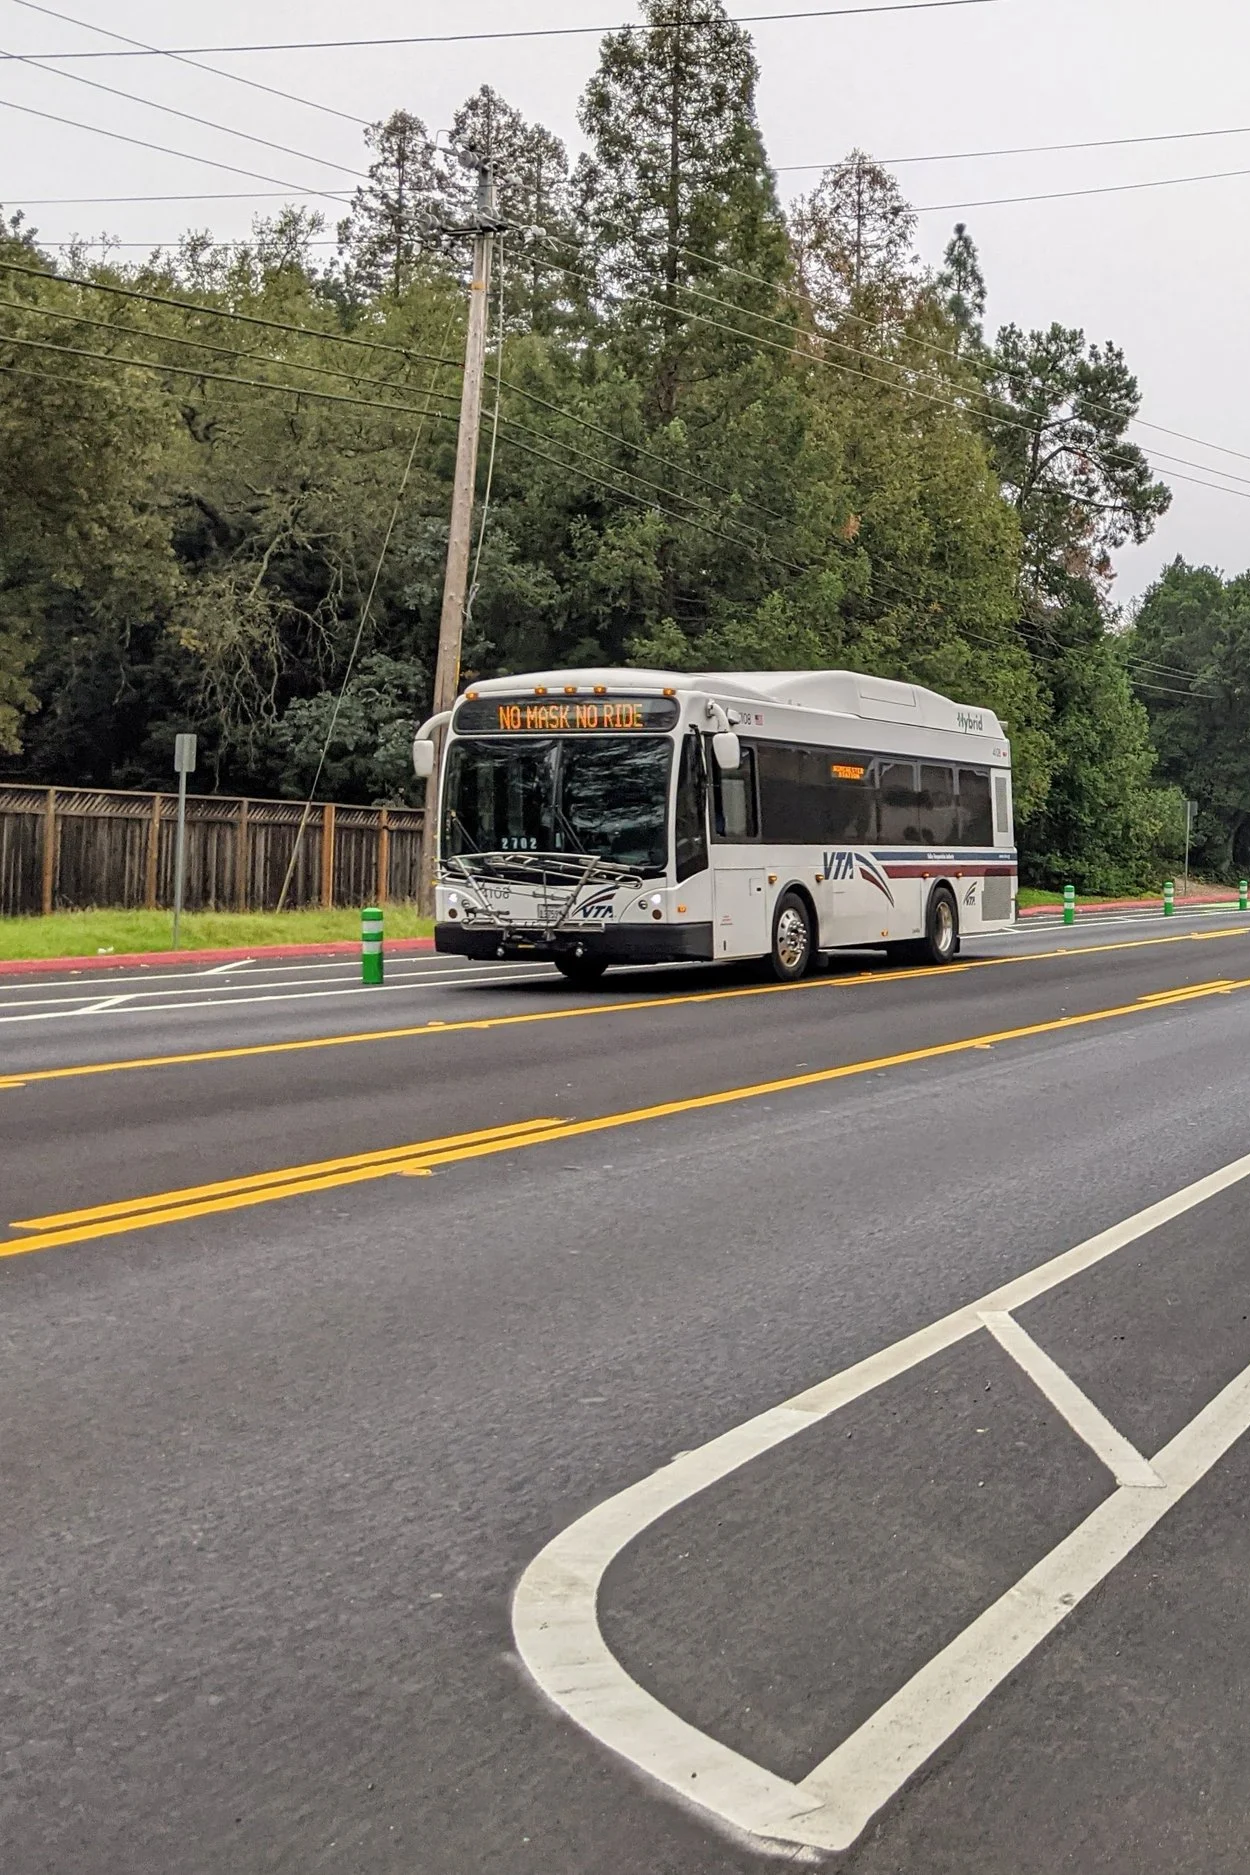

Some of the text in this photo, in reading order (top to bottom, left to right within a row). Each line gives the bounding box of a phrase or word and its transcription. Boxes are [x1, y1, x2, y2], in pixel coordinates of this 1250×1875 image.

[499, 703, 644, 730] NO MASK NO RIDE
[957, 711, 983, 734] Hybrid
[501, 837, 537, 849] 2702
[823, 851, 854, 880] VTA
[581, 905, 614, 918] VTA
